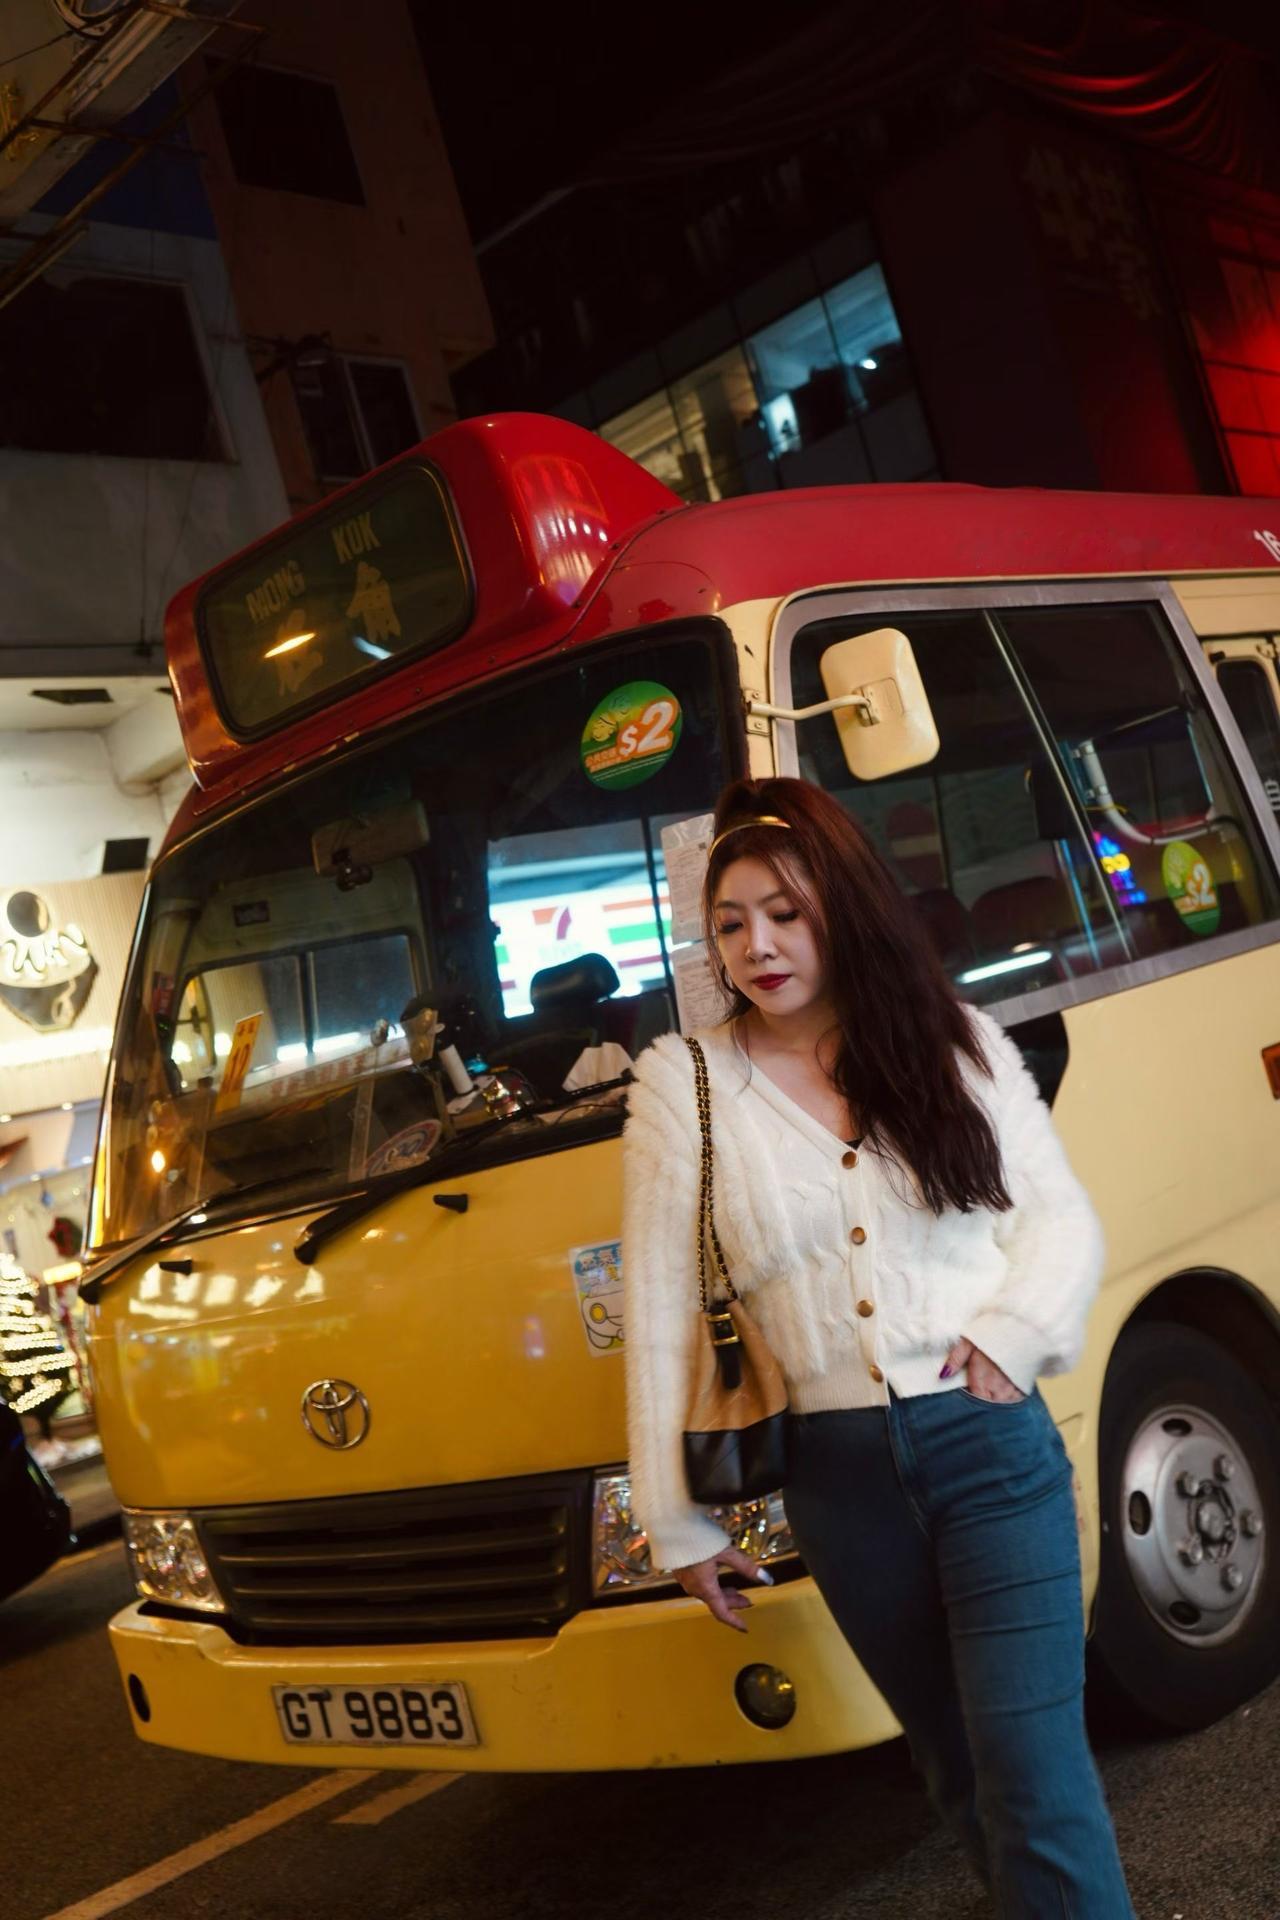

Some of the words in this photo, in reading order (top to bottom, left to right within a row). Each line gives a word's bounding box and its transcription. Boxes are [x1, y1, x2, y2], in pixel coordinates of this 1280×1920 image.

[244, 560, 306, 624] MONG
[330, 512, 381, 563] KOK
[282, 1689, 332, 1738] GT
[344, 1689, 464, 1740] 9883
